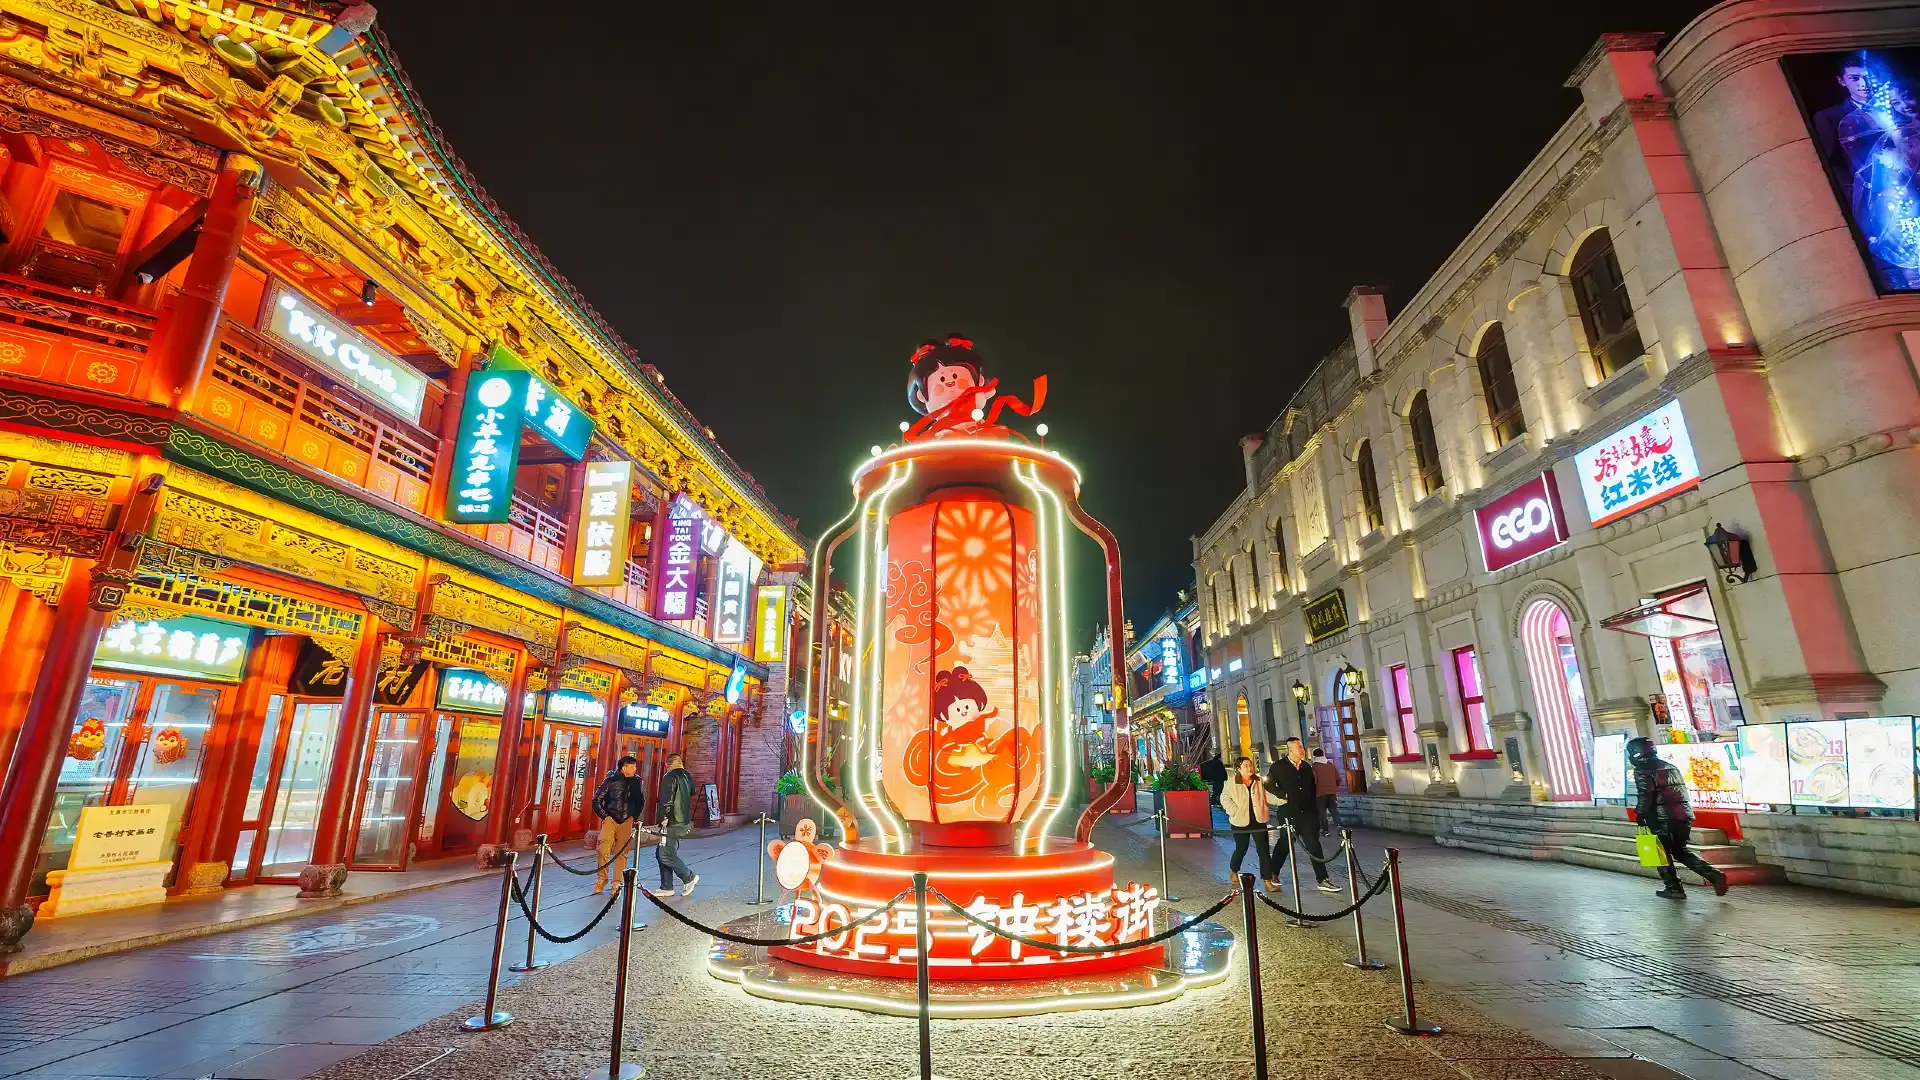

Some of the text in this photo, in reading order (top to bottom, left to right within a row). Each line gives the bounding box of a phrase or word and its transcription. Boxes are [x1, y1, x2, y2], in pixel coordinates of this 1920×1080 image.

[289, 310, 337, 356] KK
[1601, 454, 1682, 510] 红米线
[669, 534, 692, 542] FOOK
[672, 519, 692, 527] KING
[1829, 740, 1844, 755] 13
[1791, 780, 1805, 794] 17
[791, 899, 934, 958] 2025
[967, 884, 1161, 961] 钟楼街
